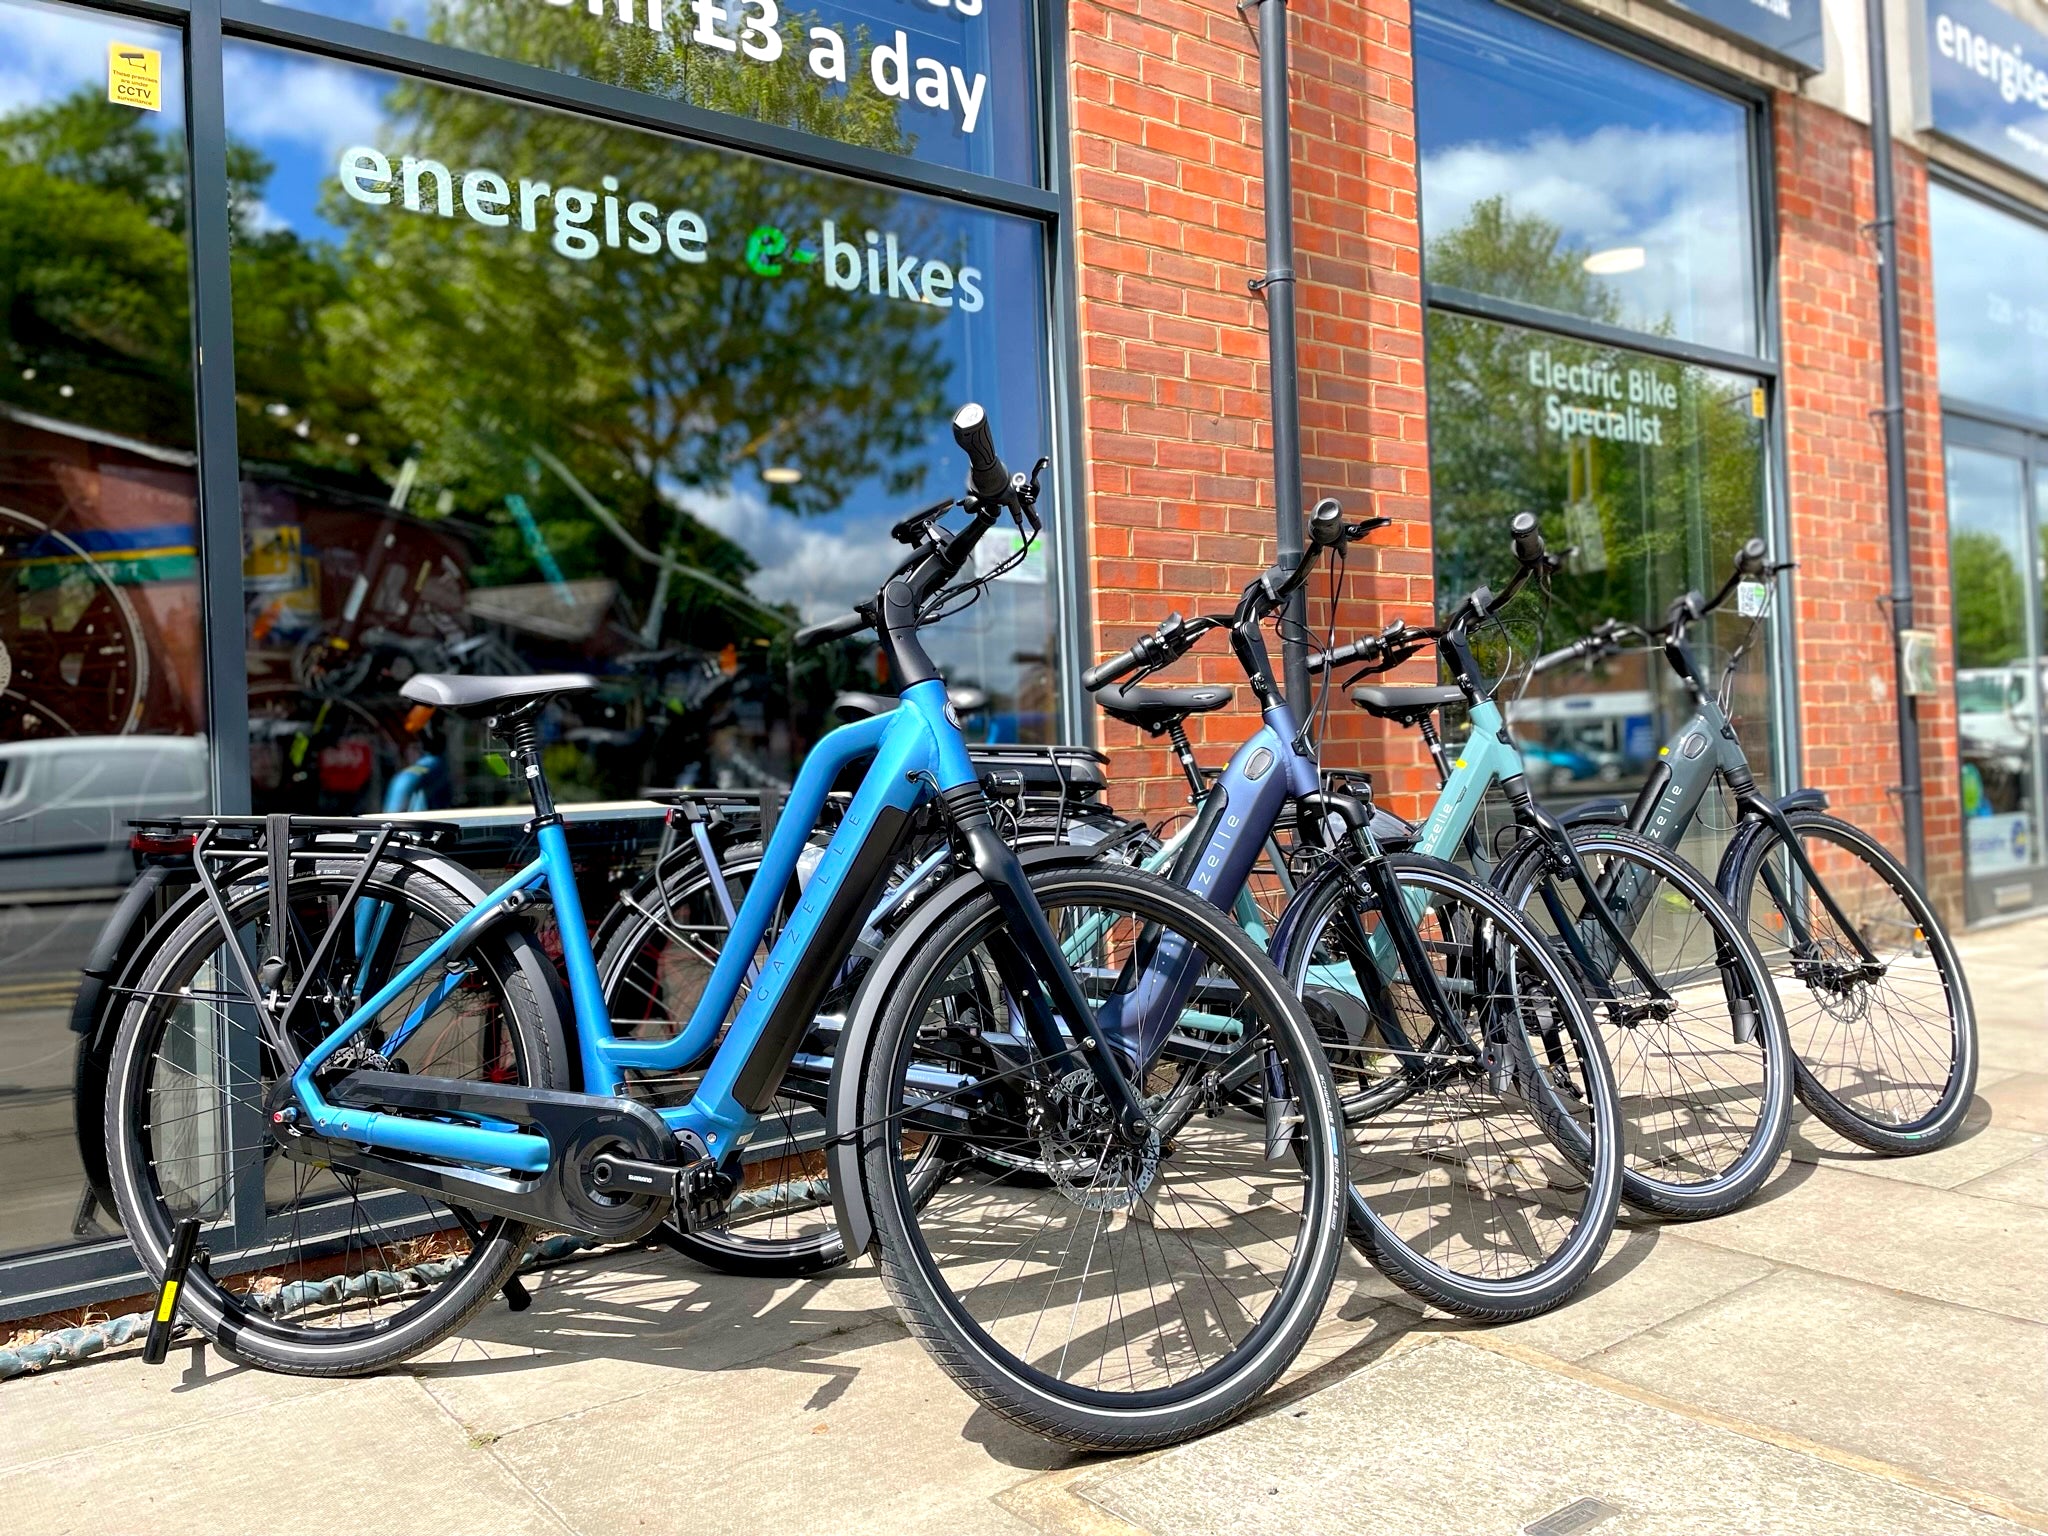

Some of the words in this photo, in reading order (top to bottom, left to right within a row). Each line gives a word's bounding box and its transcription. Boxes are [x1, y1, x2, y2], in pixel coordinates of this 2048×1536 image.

[117, 84, 151, 99] CCTV
[807, 26, 846, 83] a
[869, 30, 987, 133] day
[1936, 14, 2048, 110] energise
[339, 146, 709, 261] energise
[1529, 350, 1622, 400] Electric
[1628, 368, 1678, 409] Bike
[1545, 394, 1663, 446] Specialist
[757, 813, 861, 1002] GAZELLE
